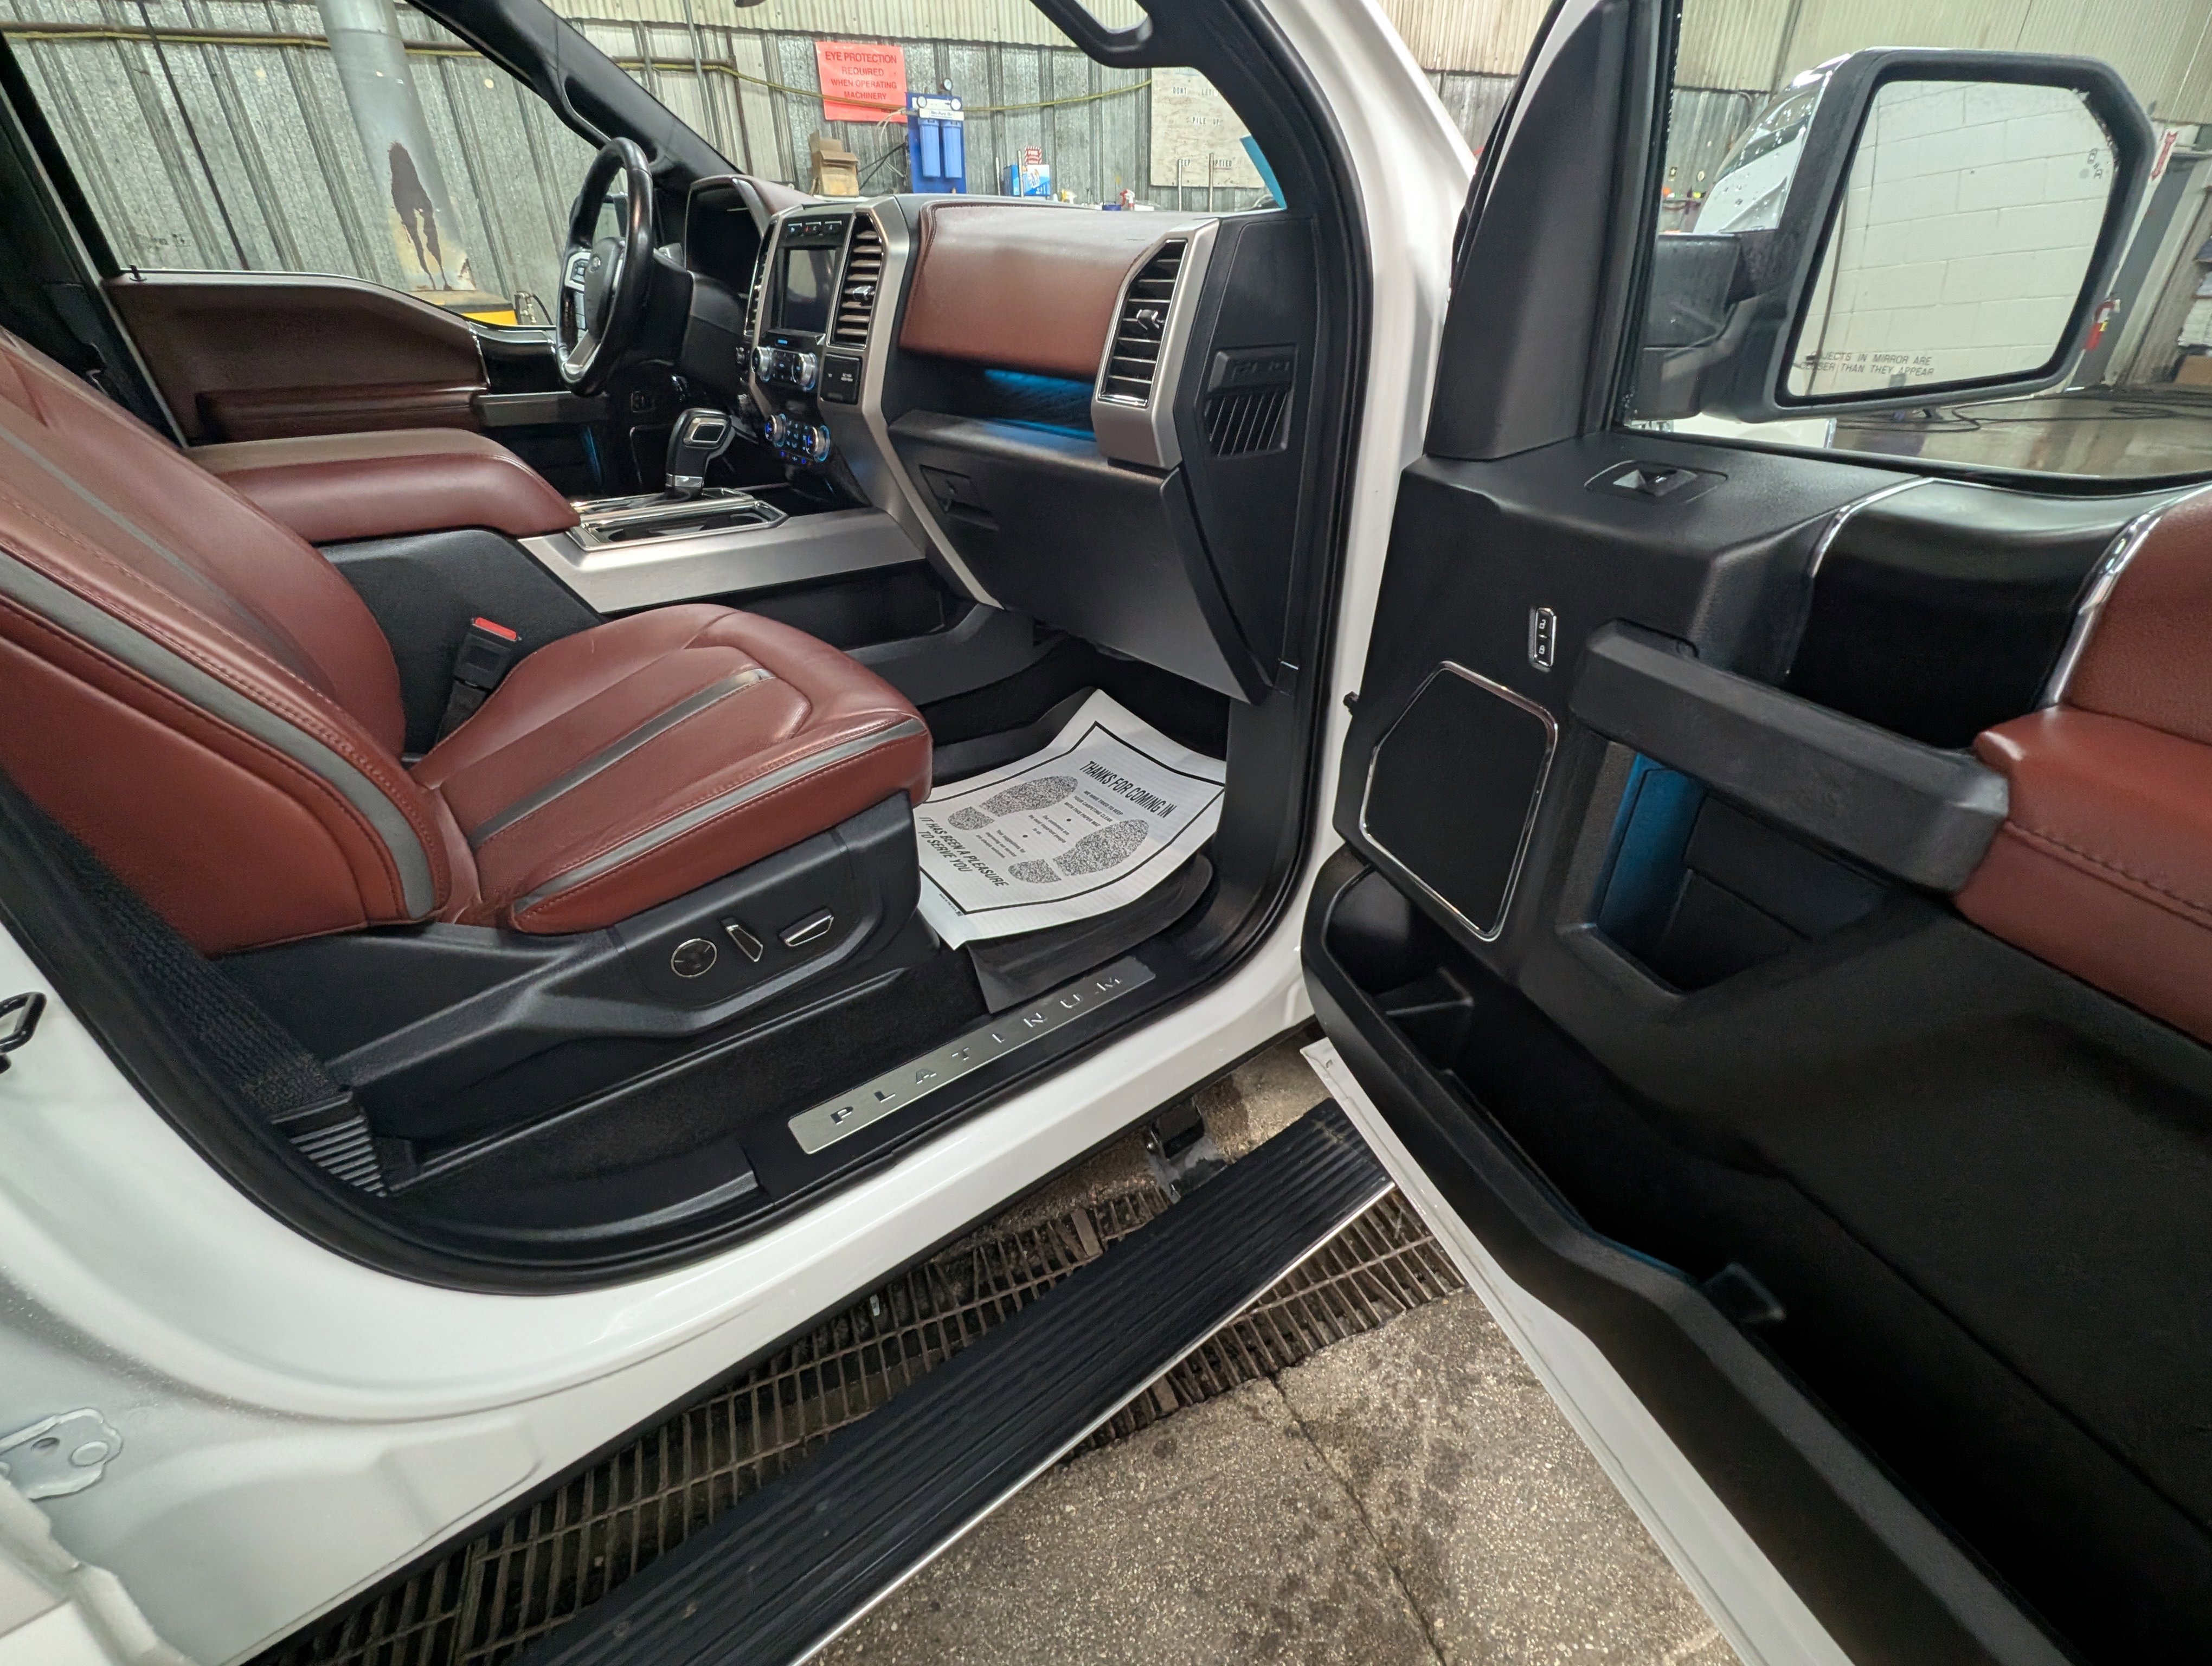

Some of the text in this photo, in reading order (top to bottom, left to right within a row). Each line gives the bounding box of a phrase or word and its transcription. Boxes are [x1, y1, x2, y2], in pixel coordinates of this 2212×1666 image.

[825, 52, 897, 63] EYE PROTECTION
[841, 66, 884, 76] REQUIRED
[856, 80, 897, 88] OPERATING
[844, 91, 887, 100] MACHINERY
[1857, 354, 1867, 362] IN
[1873, 354, 1909, 364] MIRROR
[1913, 356, 1932, 366] ARE
[1841, 363, 1866, 373] THAN
[1871, 364, 1894, 374] THEY
[1898, 366, 1934, 376] APPEAR
[1079, 760, 1177, 818] THANKS FOR COMING IN
[925, 823, 948, 835] HAS
[940, 835, 966, 850] BEEN
[963, 855, 1009, 887] PLEASURE
[927, 840, 957, 858] SERVE
[949, 859, 973, 872] YOU
[829, 974, 1122, 1125] PLATINUM
